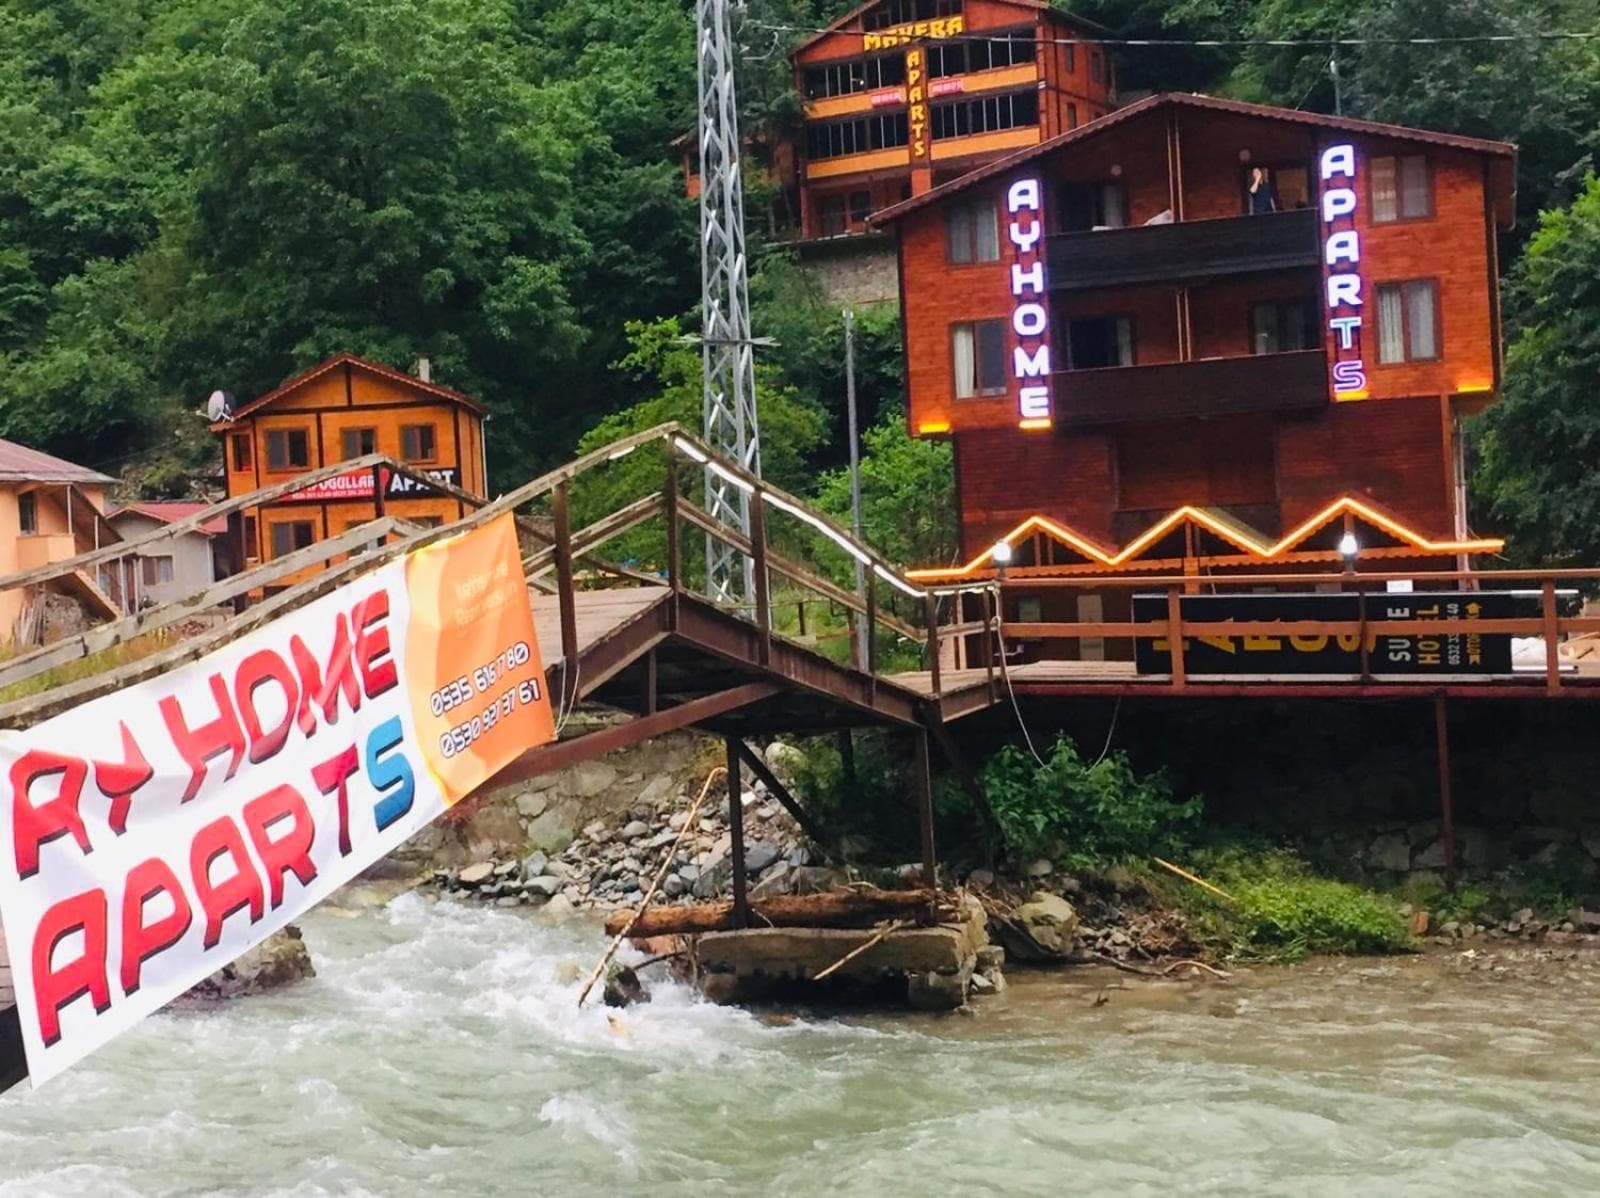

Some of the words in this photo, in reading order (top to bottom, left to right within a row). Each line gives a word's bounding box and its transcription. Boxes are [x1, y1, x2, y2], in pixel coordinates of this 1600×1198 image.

[864, 16, 963, 51] MAVERA
[907, 50, 926, 157] APARTS
[1008, 179, 1051, 418] AYHOME
[1320, 144, 1366, 392] APARTS
[1386, 607, 1411, 662] SUE
[1416, 604, 1440, 664] HOL
[158, 588, 399, 804] HOME
[431, 675, 474, 717] 0535
[440, 714, 481, 758] 0530
[519, 677, 541, 705] 61
[31, 714, 416, 1049] APARTS
